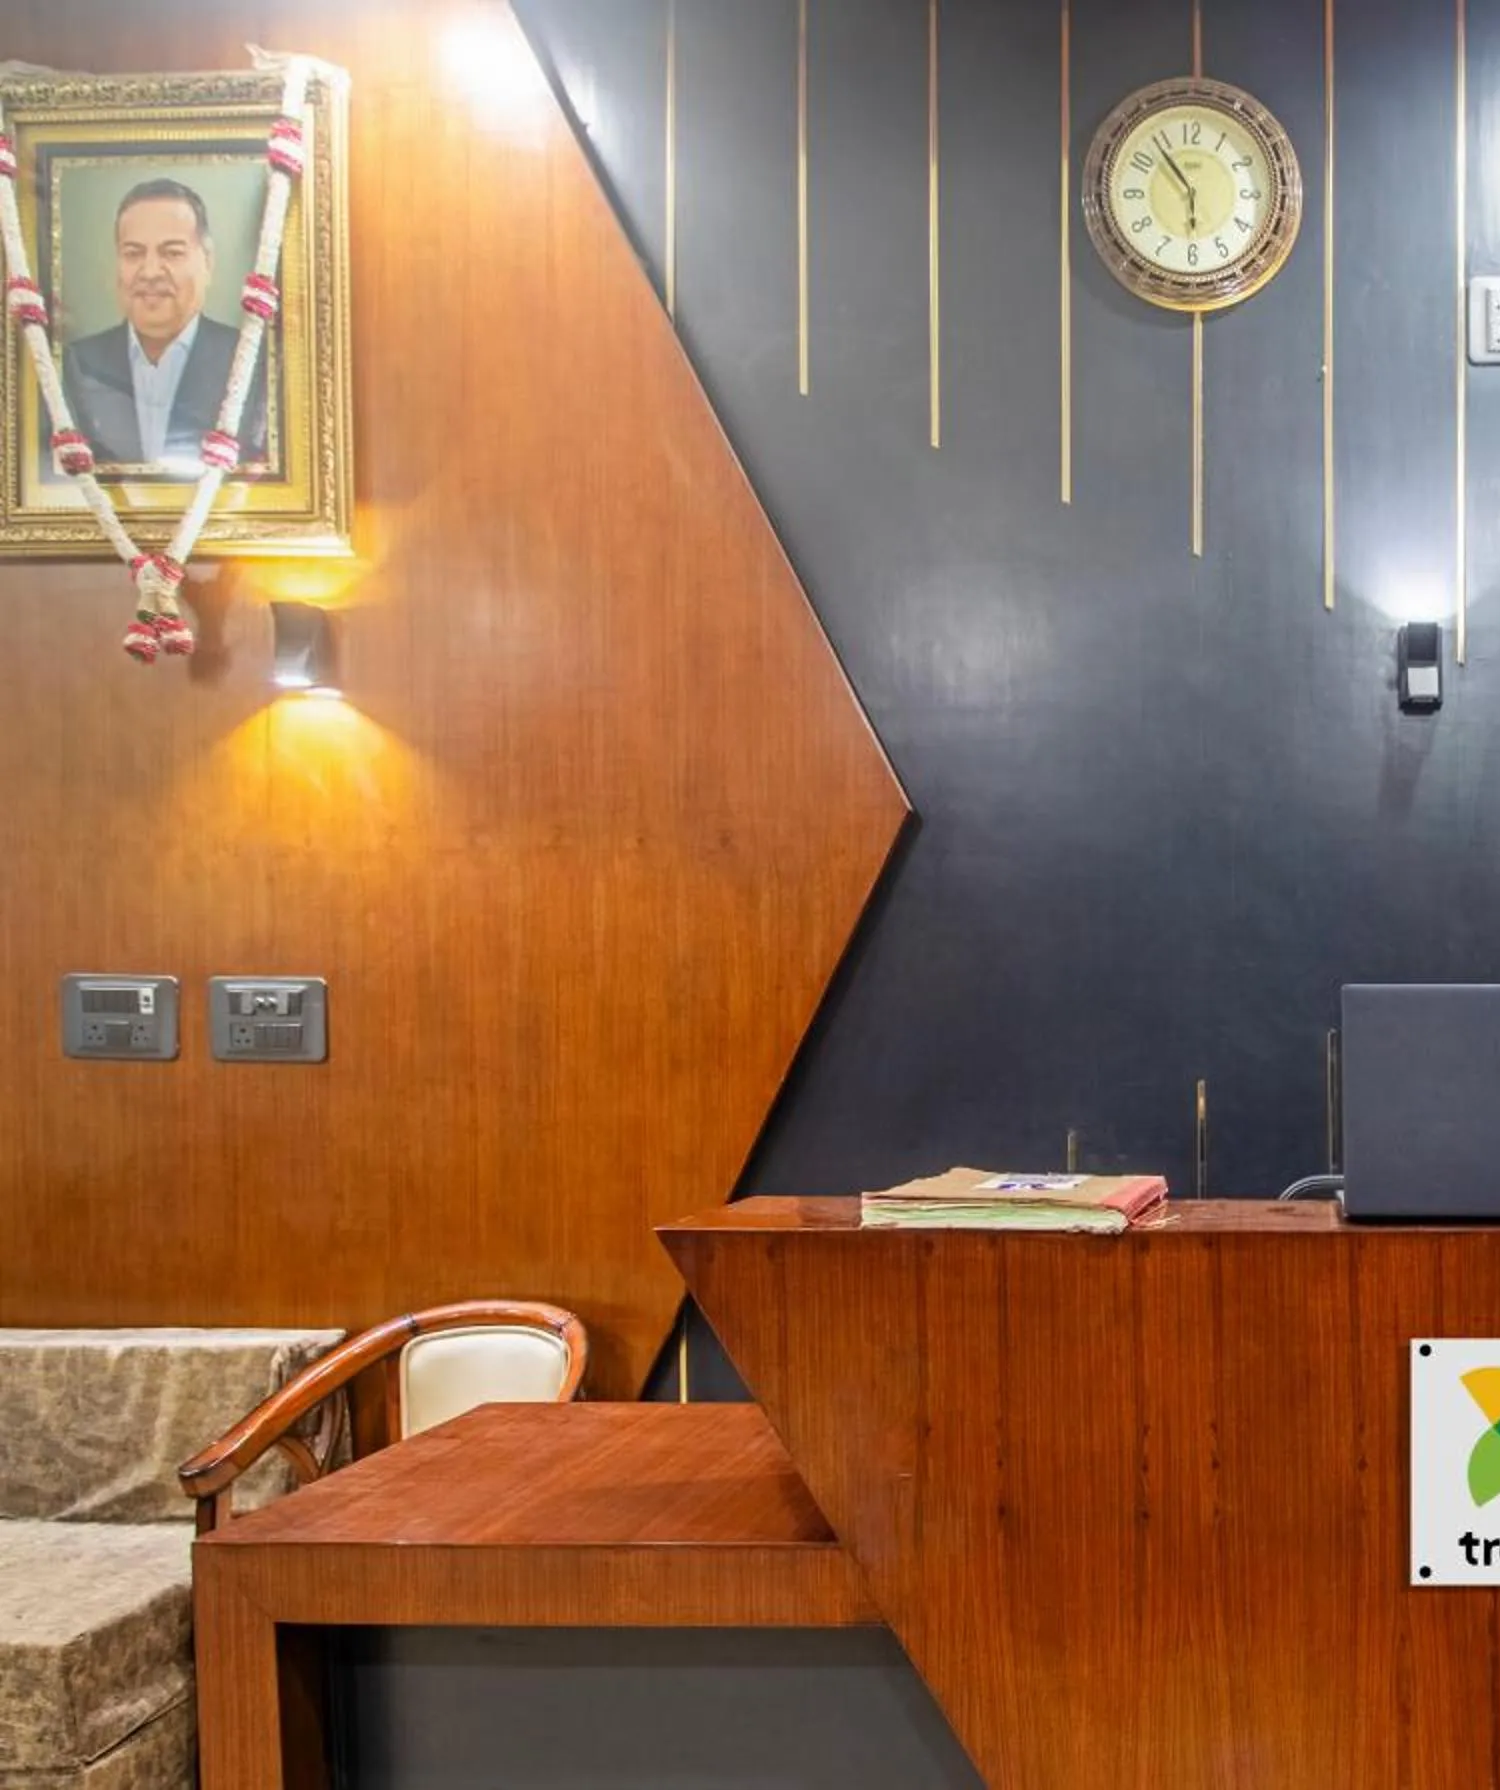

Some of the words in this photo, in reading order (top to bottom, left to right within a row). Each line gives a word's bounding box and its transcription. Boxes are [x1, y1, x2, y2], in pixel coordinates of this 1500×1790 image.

[1152, 129, 1173, 150] 1
[1182, 122, 1201, 145] 12
[1215, 132, 1227, 151] 1
[1130, 152, 1153, 174] 10
[1231, 155, 1252, 172] 2
[1123, 189, 1144, 199] 9
[1240, 189, 1261, 200] 3
[1132, 217, 1152, 233] 8
[1234, 217, 1253, 233] 4
[1155, 235, 1172, 257] 7
[1187, 244, 1198, 266] 6
[1215, 237, 1229, 258] 5
